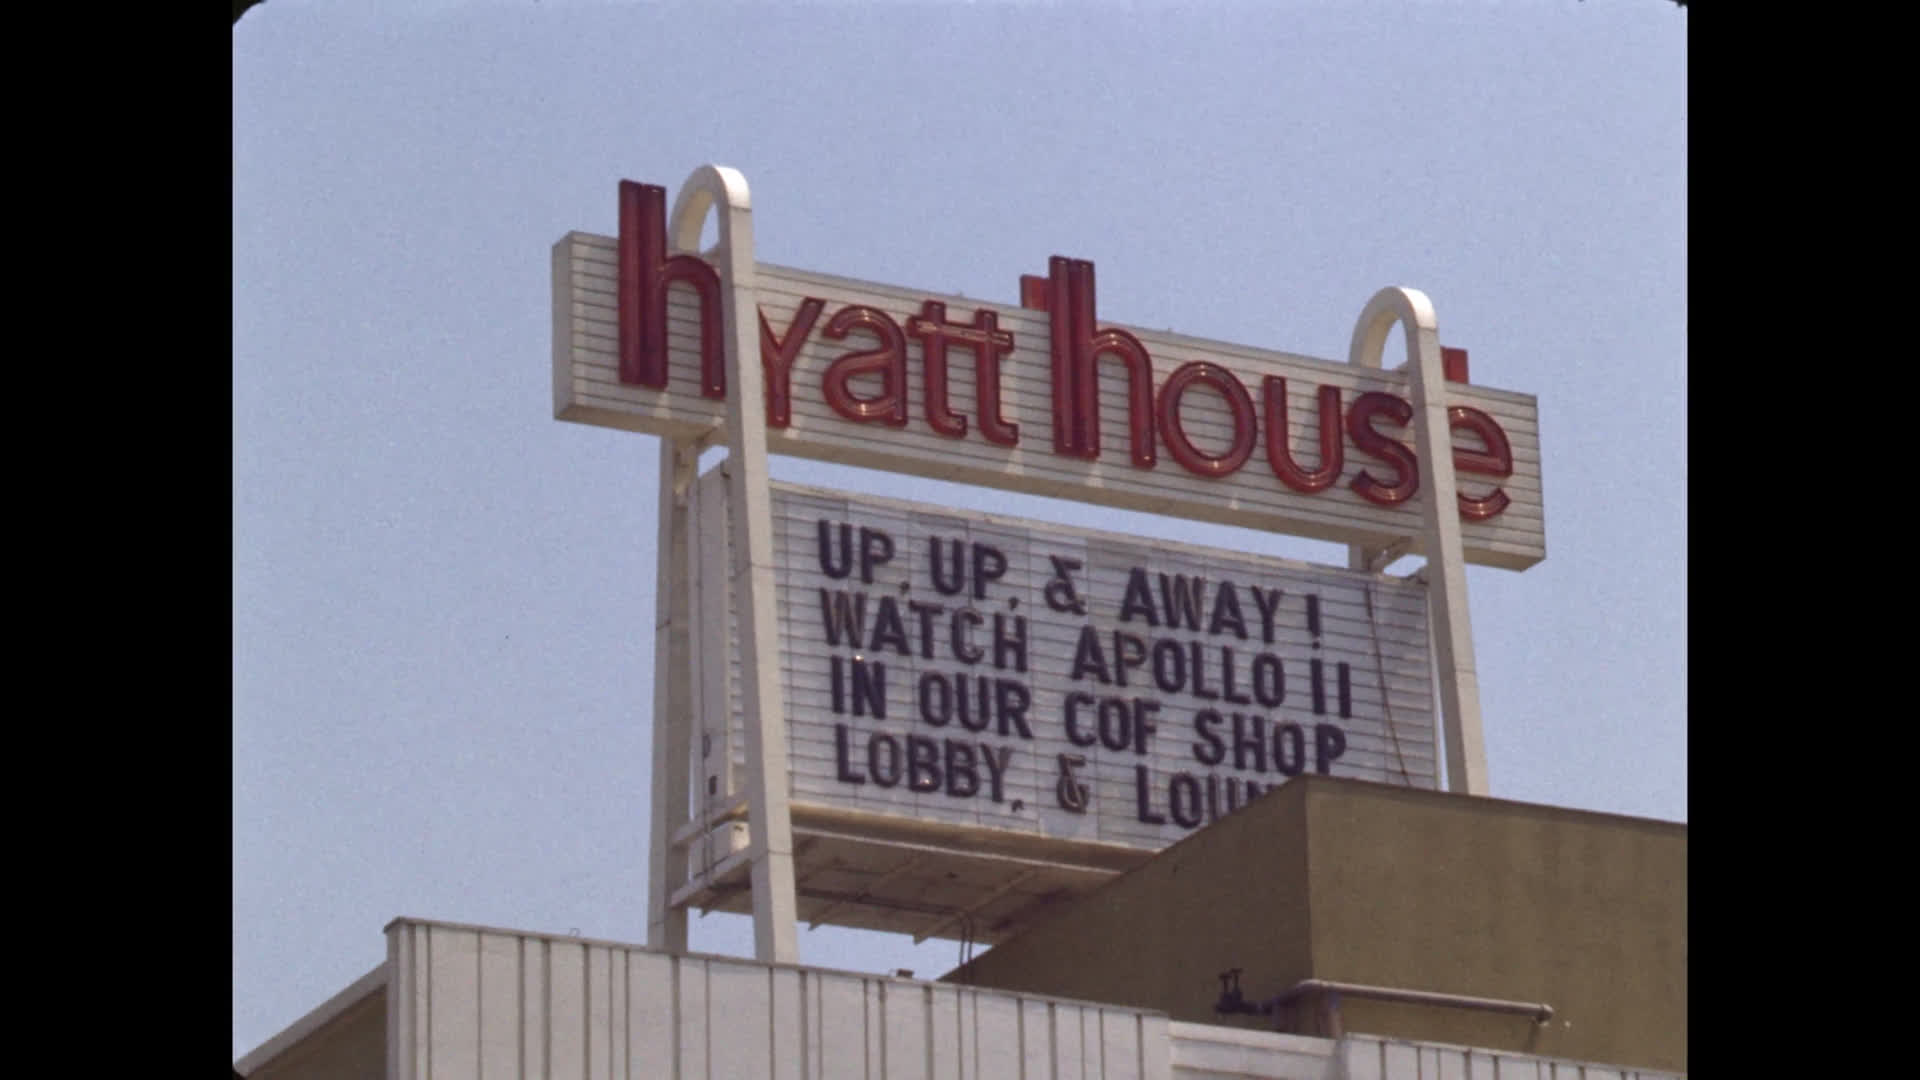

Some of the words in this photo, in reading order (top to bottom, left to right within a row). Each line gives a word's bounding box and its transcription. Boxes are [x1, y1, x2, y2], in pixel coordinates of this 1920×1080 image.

[618, 180, 1018, 447] hyatt
[1049, 255, 1513, 521] house
[1044, 554, 1087, 616] &
[819, 588, 1028, 674] WATCH
[1072, 625, 1287, 708] APOLLO
[831, 654, 886, 721] IN
[919, 671, 1032, 740] OUR
[1064, 690, 1161, 756] COF
[1192, 708, 1347, 776] SHOP
[1056, 753, 1090, 814] &
